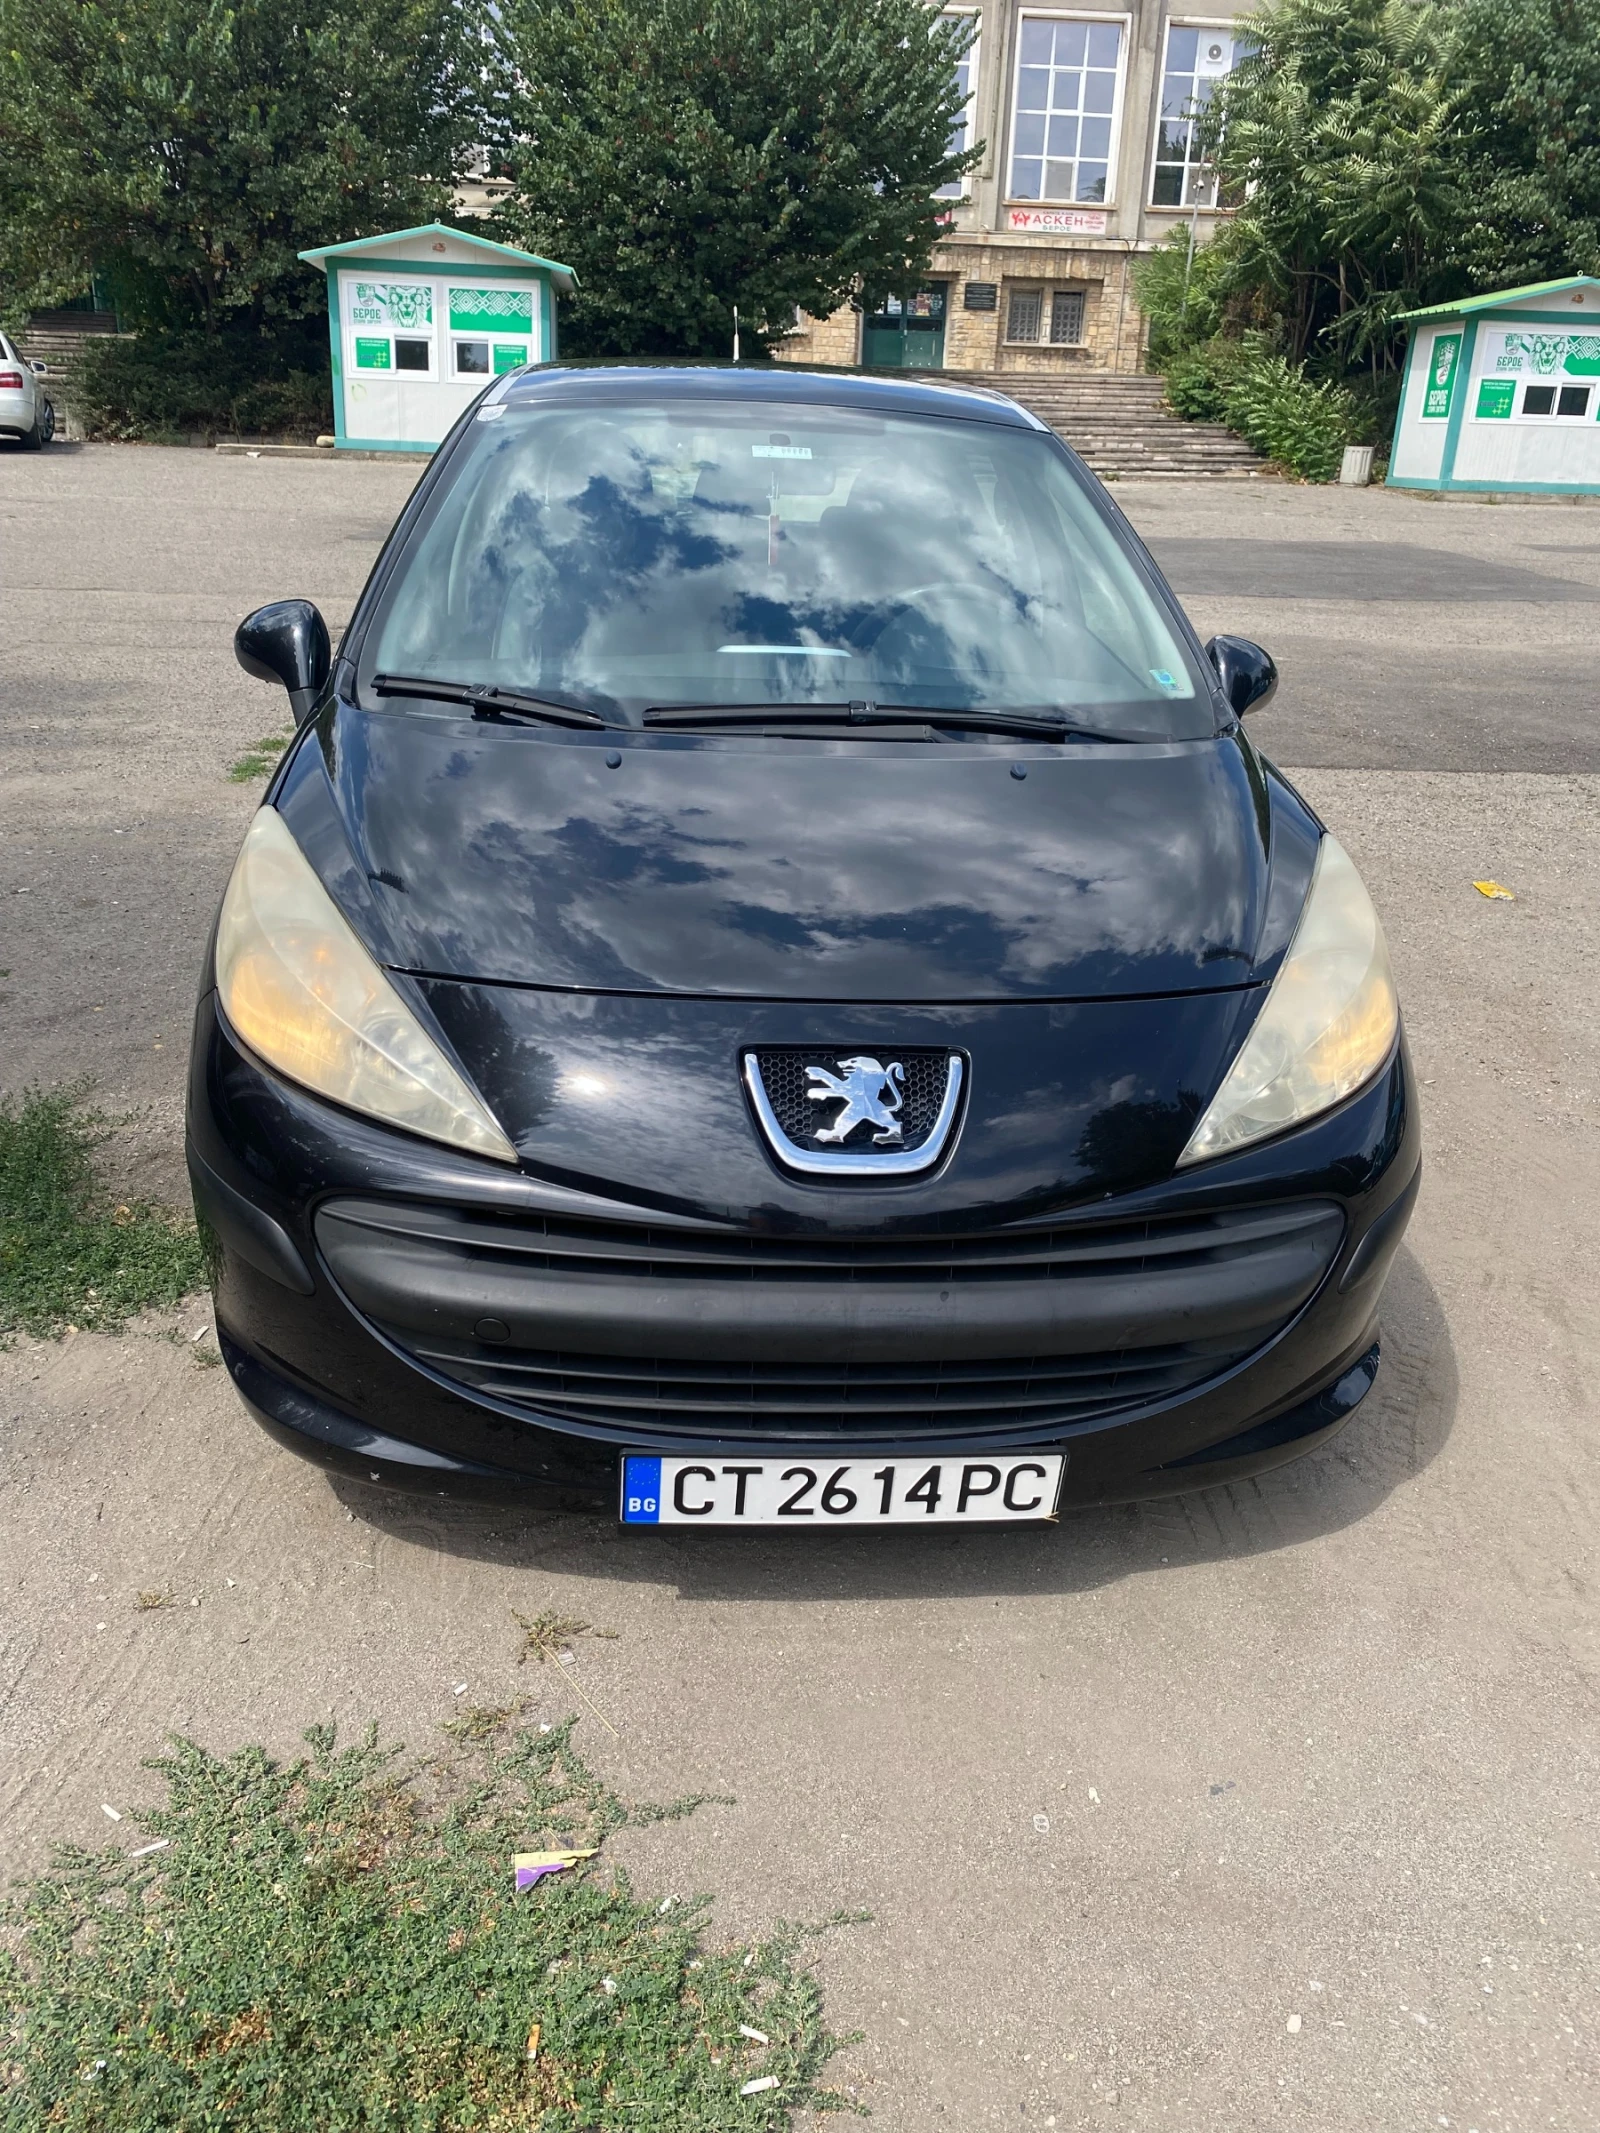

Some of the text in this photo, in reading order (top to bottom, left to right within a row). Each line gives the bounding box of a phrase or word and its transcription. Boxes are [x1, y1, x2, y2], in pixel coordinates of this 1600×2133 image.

[1033, 215, 1083, 226] АСКЕН
[353, 308, 381, 319] БЕРОЕ
[1496, 356, 1523, 366] БЕРОЕ
[628, 1497, 657, 1513] BG
